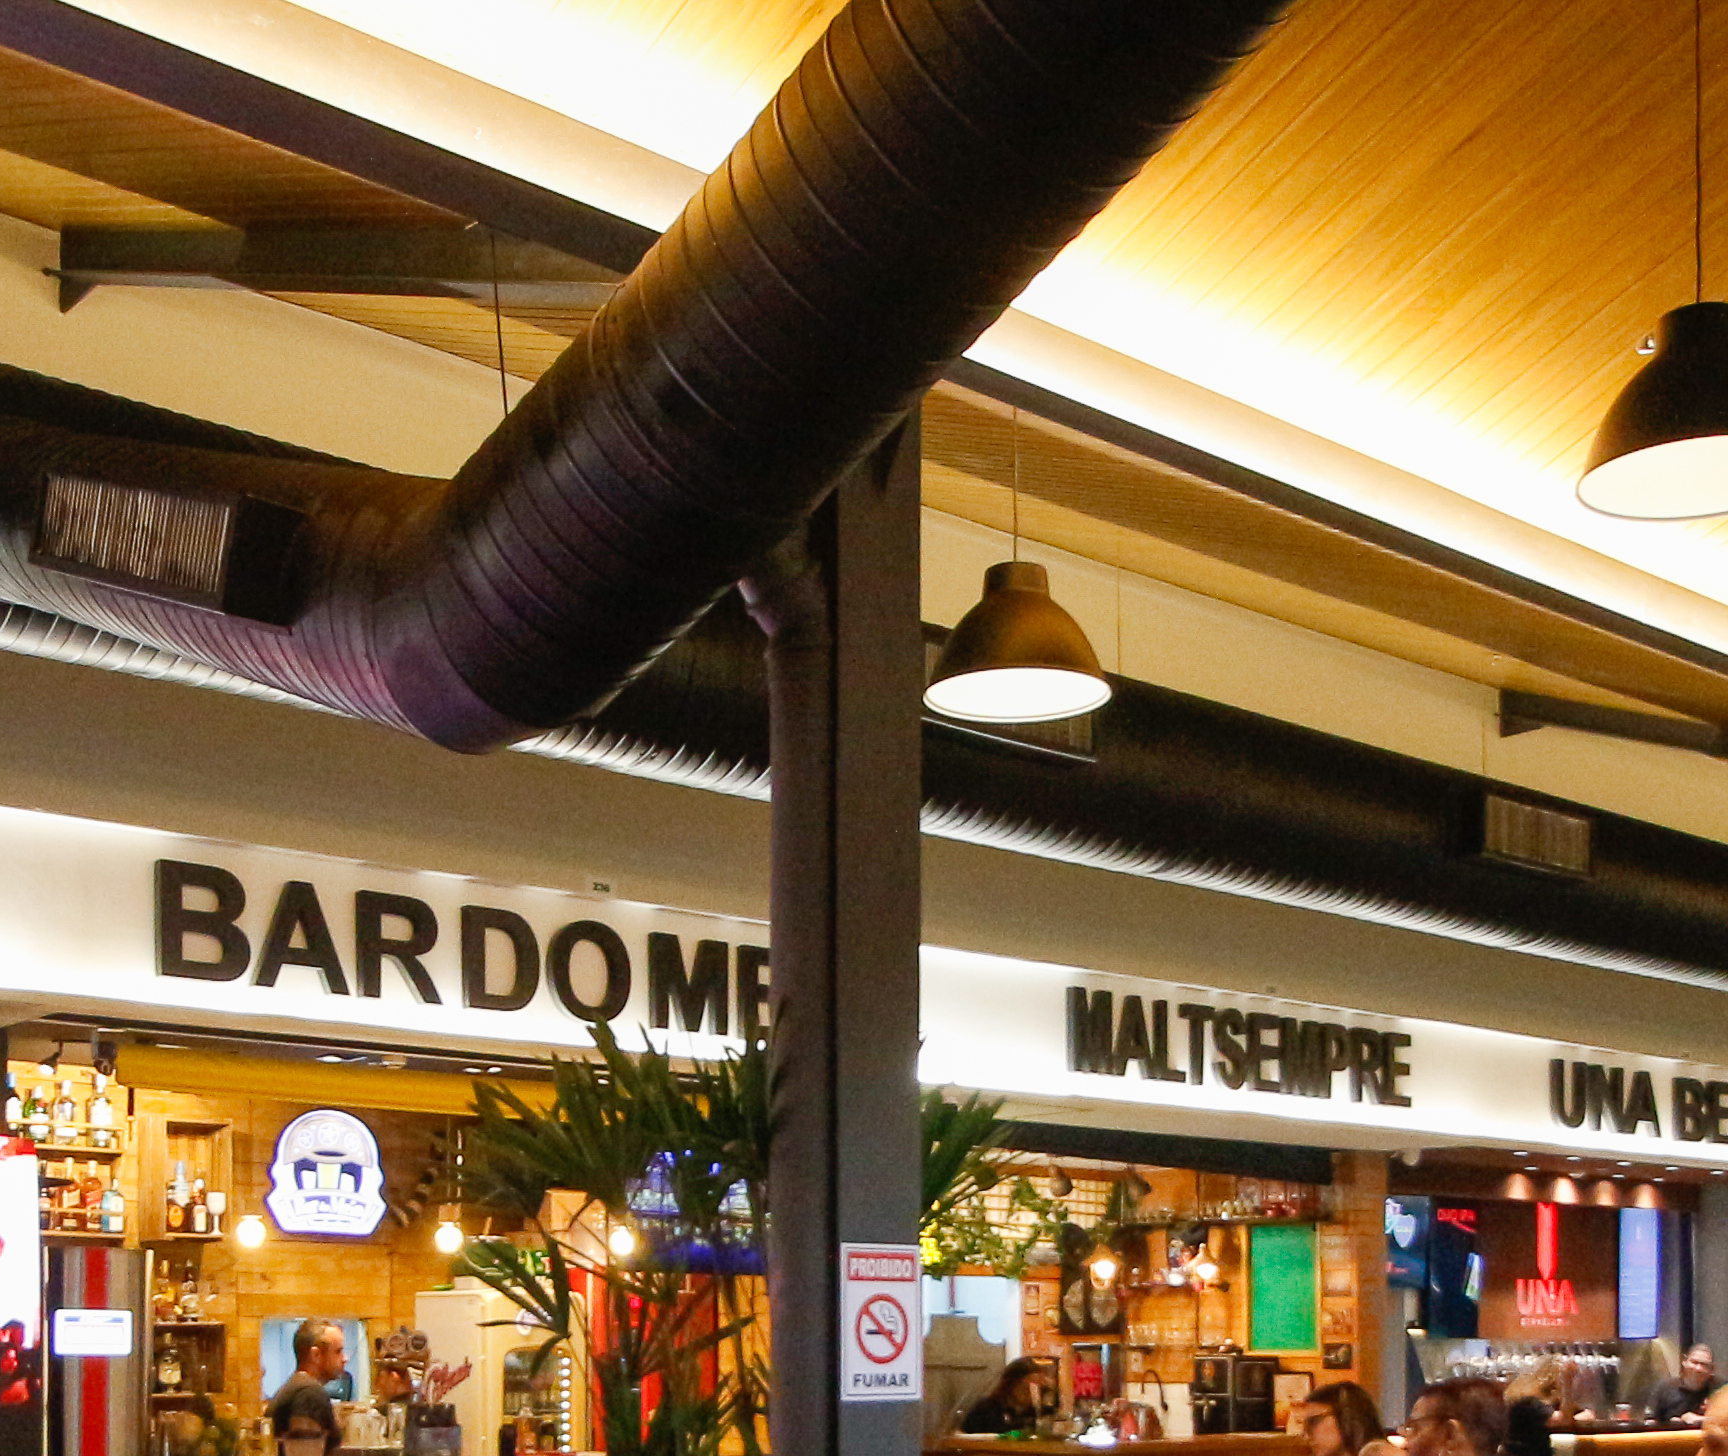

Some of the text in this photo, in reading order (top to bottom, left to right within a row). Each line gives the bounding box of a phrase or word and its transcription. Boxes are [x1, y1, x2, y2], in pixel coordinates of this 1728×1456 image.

[1066, 986, 1412, 1108] MALTSEMPRE
[1548, 1058, 1662, 1138] UNA
[849, 1257, 912, 1277] PROIBIDO
[1515, 1278, 1579, 1315] UNA
[852, 1373, 910, 1388] FUMAR
